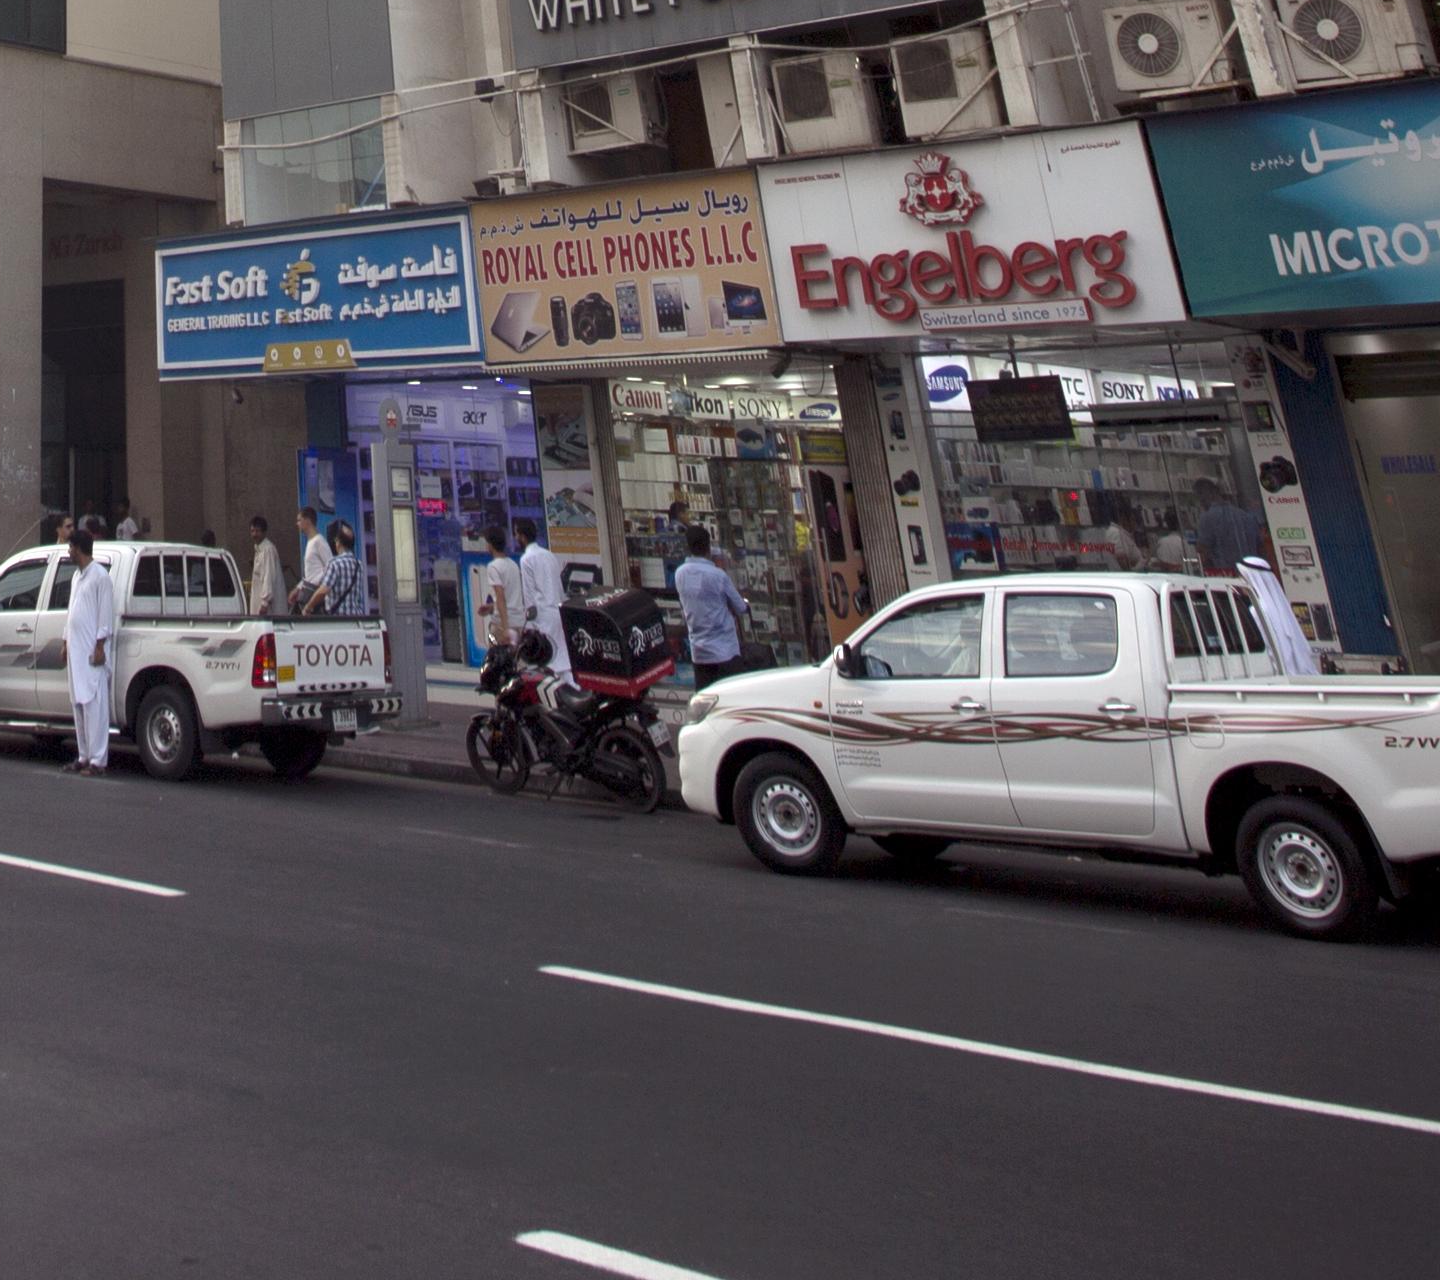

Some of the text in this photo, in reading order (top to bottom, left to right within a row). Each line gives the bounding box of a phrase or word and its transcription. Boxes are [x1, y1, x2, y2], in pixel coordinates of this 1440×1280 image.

[529, 200, 622, 231] للهواتف
[629, 197, 690, 224] سيل
[697, 190, 749, 217] رويال
[482, 221, 758, 285] ROYAL CELL PHONES L.L.C
[337, 244, 458, 288] فاست سوفت
[790, 230, 1137, 322] Engelberg
[165, 265, 268, 306] Fast Soft
[167, 315, 207, 333] GENERAL
[207, 312, 245, 329] TRADING
[275, 304, 333, 325] Fast Soft
[922, 306, 1086, 328] Switzerland since 1975
[926, 368, 966, 391] SAMSUNG
[1102, 381, 1144, 401] SONY
[612, 383, 663, 409] Canon
[683, 389, 725, 415] ikon
[738, 394, 782, 418] SONY
[462, 409, 487, 425] acer
[1380, 454, 1436, 475] WHOLESALE
[293, 644, 372, 667] TOYOTA
[1384, 736, 1414, 749] 2.7
